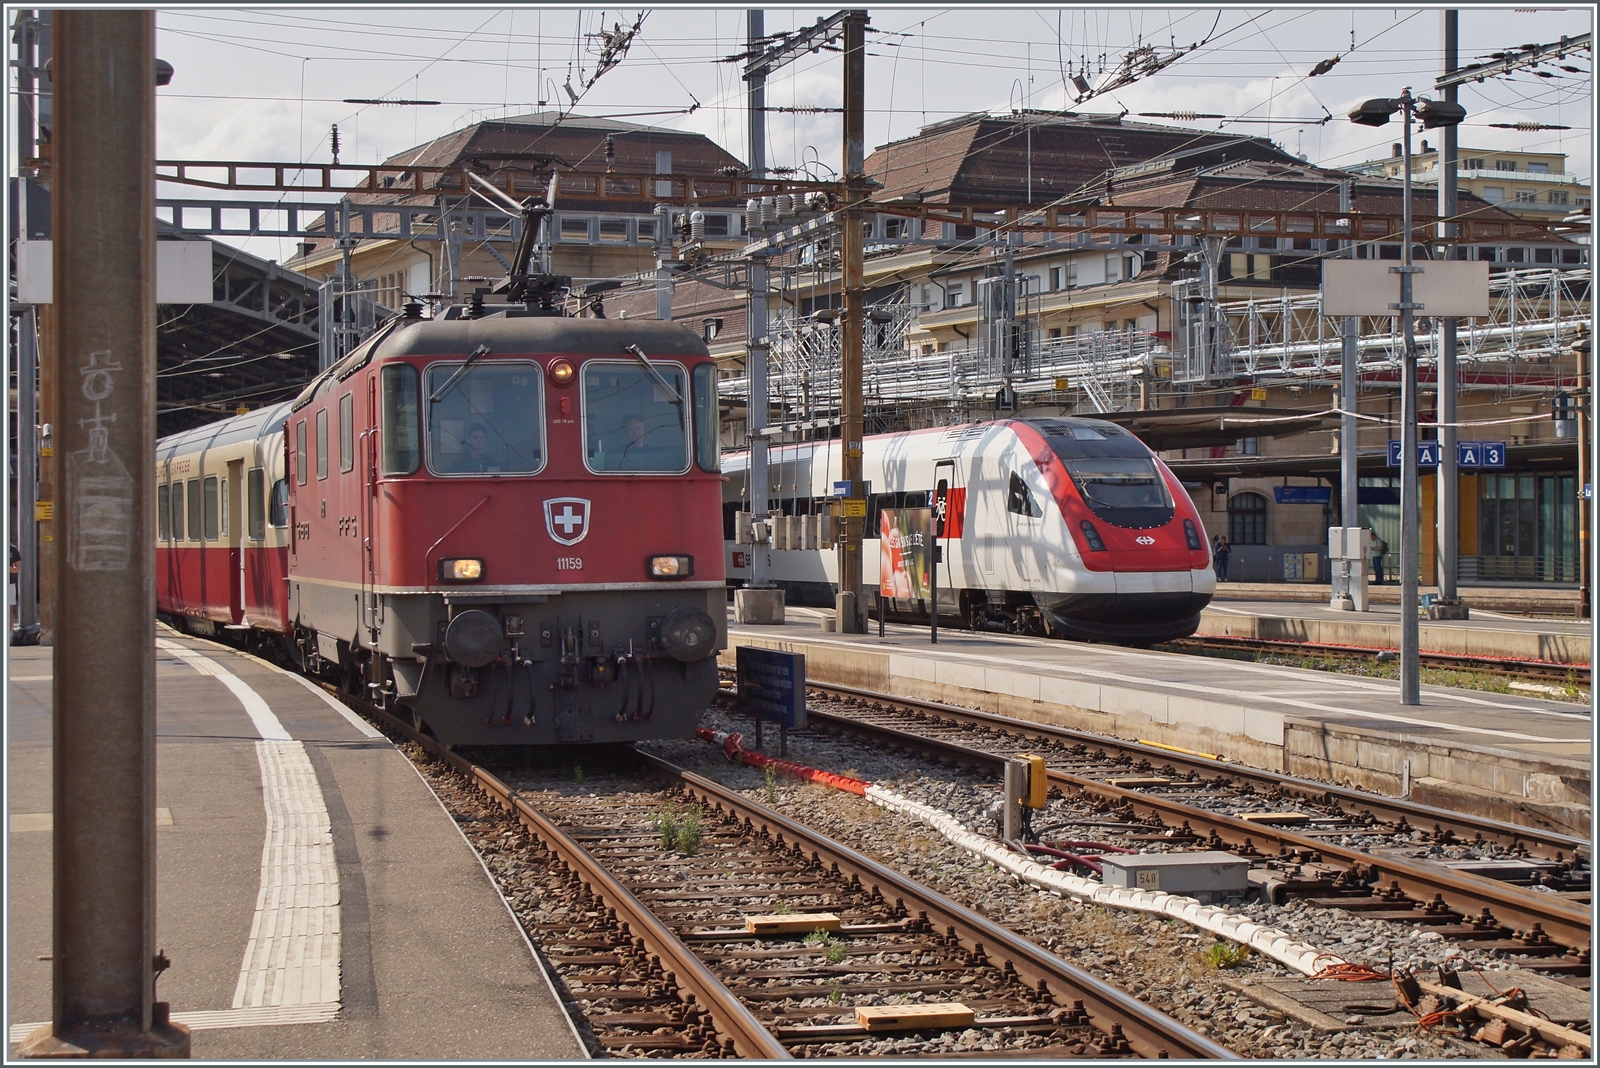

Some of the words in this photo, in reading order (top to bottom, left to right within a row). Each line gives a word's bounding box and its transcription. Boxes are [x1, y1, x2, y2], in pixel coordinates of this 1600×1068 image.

[1420, 449, 1433, 463] A
[1464, 450, 1476, 464] A
[1489, 449, 1499, 464] 3
[171, 459, 191, 475] EXPRESS
[928, 491, 934, 505] 2
[339, 516, 358, 538] FFS
[556, 557, 583, 570] 11159
[1139, 873, 1156, 884] 548
